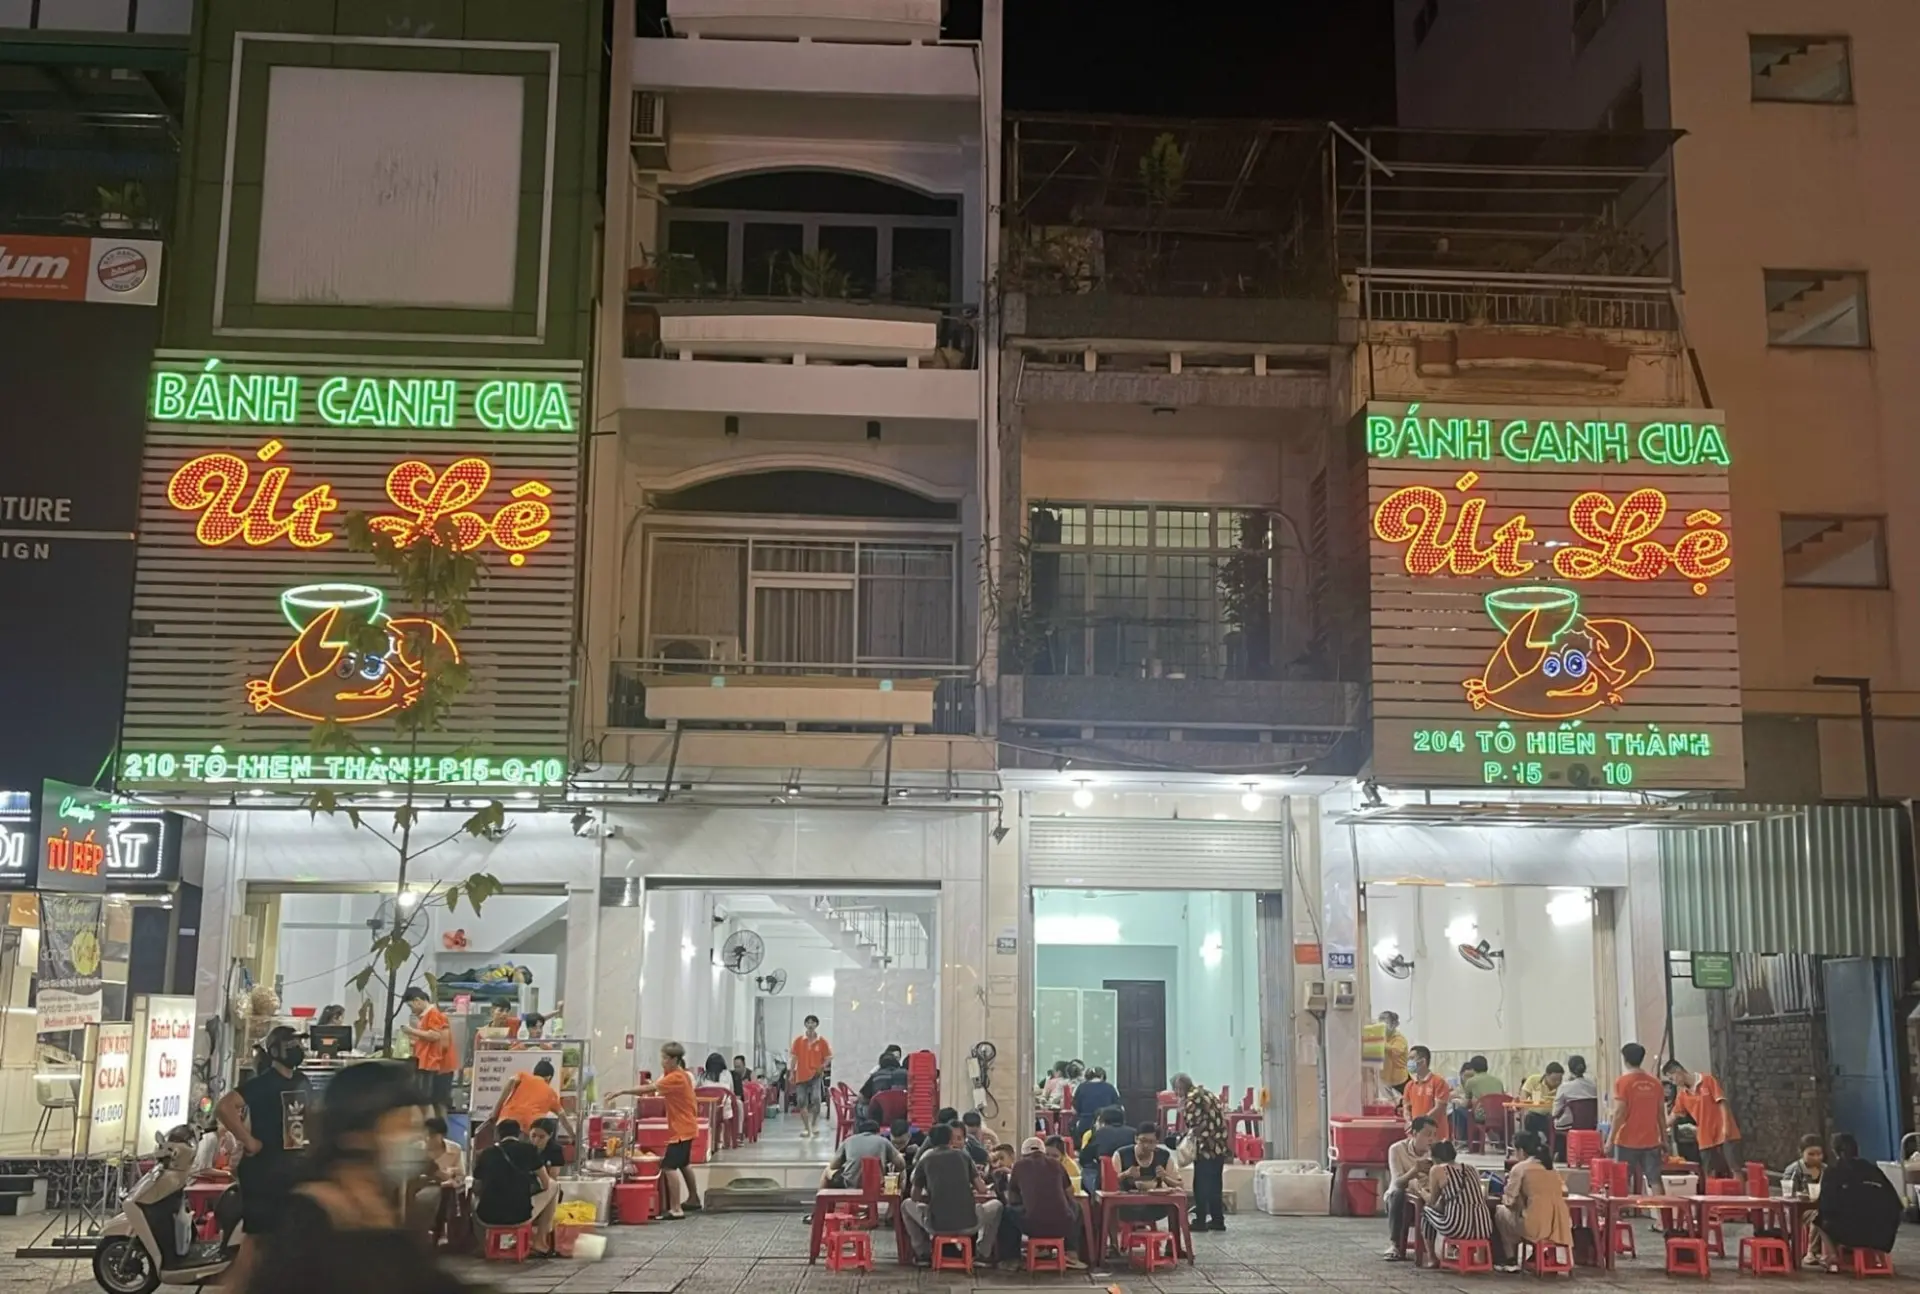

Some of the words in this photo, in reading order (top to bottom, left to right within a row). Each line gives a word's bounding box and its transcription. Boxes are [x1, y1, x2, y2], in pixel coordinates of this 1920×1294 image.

[153, 358, 298, 422] BÁNH
[317, 376, 455, 427] CANH
[475, 380, 573, 431] CUA
[1367, 403, 1490, 460] BÁNH
[1500, 419, 1629, 463] CANH
[1638, 422, 1731, 466] CUA
[0, 496, 71, 522] TURE
[168, 439, 338, 548] Út
[368, 458, 552, 567] Lệ
[1374, 471, 1534, 577] Út
[1554, 488, 1731, 596] Lệ
[1413, 730, 1465, 752] 204
[1476, 721, 1516, 753] TÔ
[1526, 720, 1596, 755] HIẾN
[1605, 723, 1710, 756] THÀNH
[123, 753, 176, 777] 210
[184, 745, 228, 778] TÔ
[98, 1067, 125, 1089] CUA
[159, 1052, 178, 1078] Cua
[148, 1095, 181, 1118] 55.000
